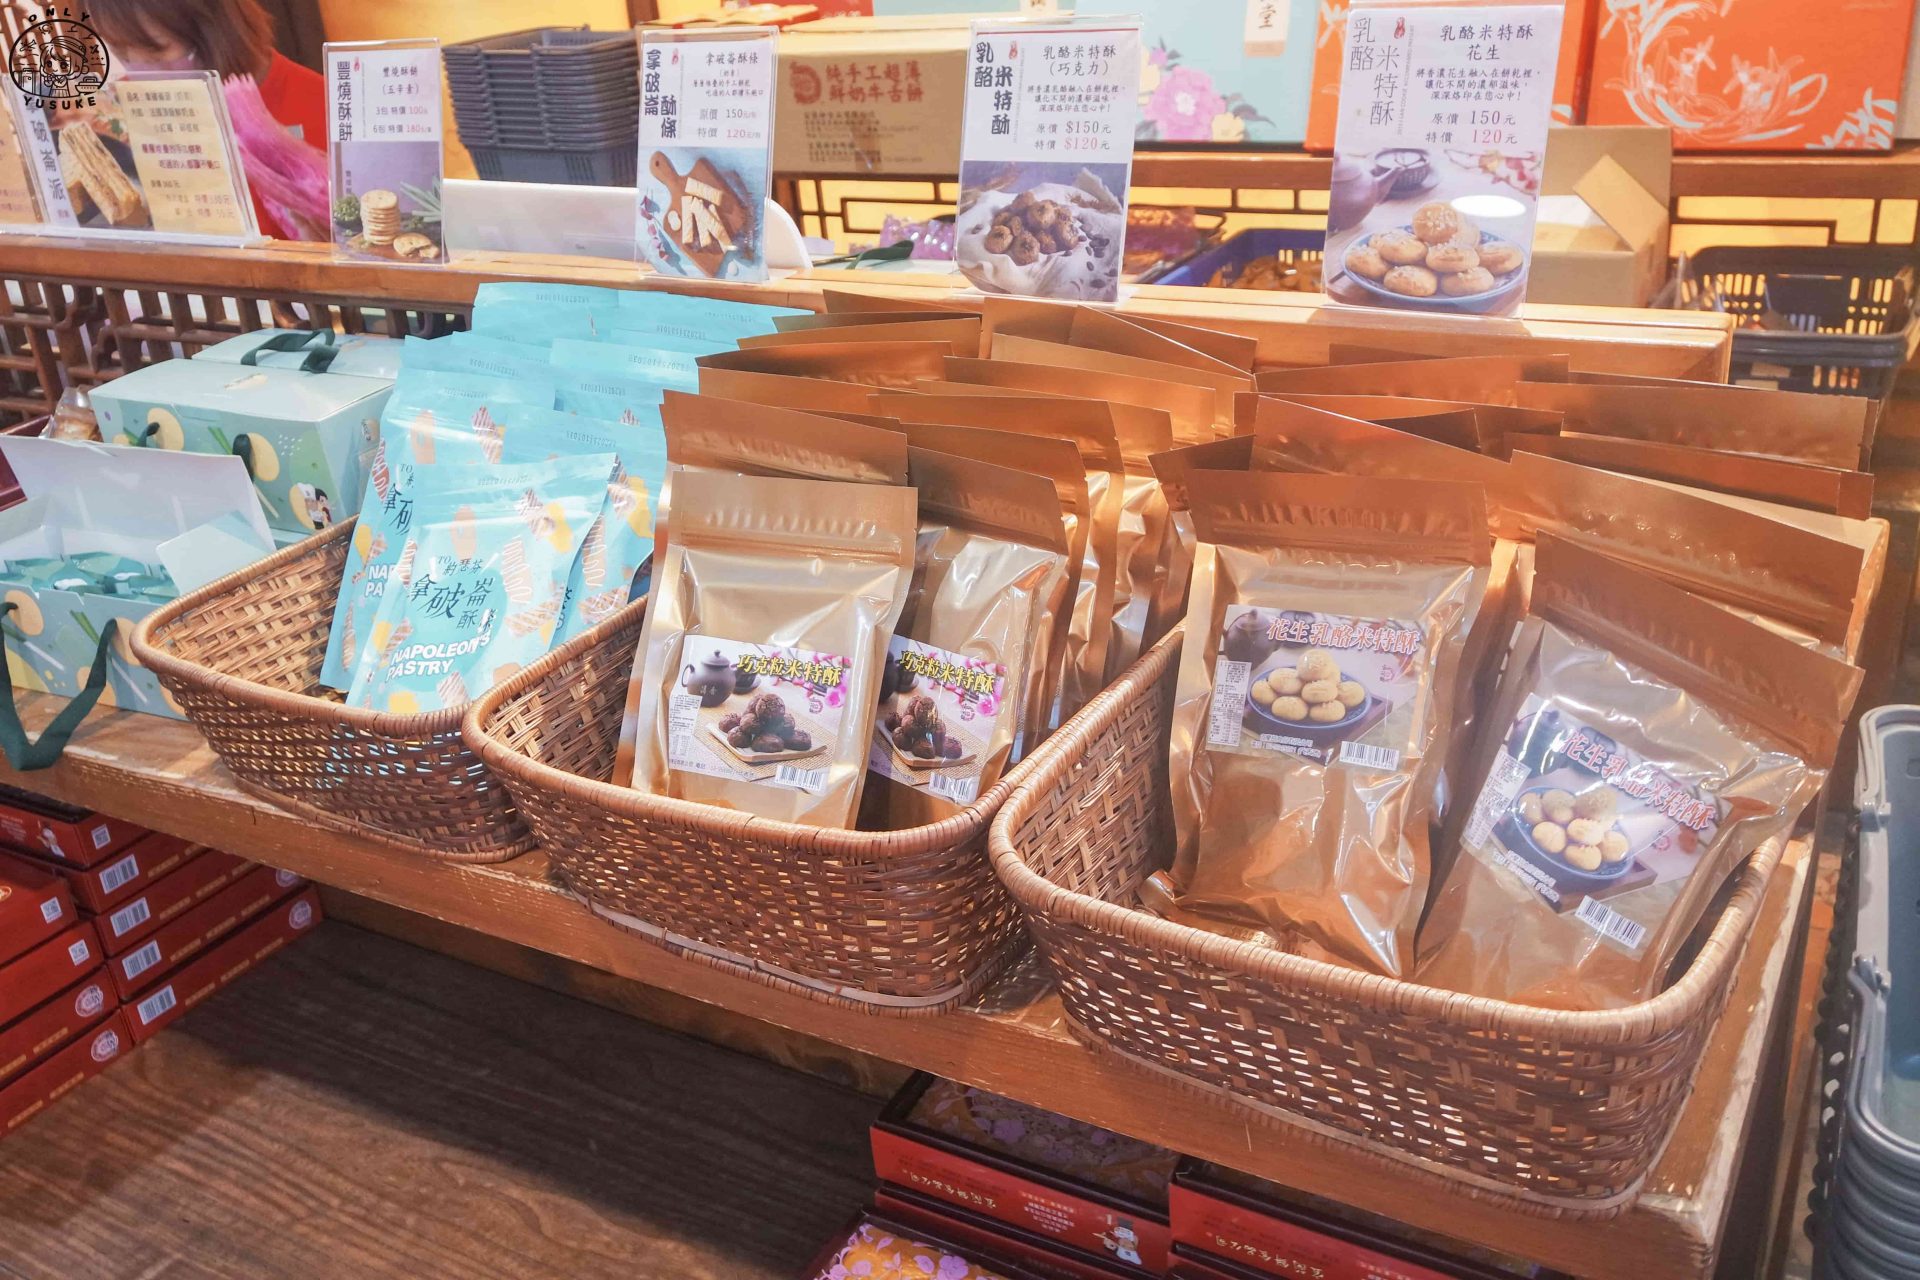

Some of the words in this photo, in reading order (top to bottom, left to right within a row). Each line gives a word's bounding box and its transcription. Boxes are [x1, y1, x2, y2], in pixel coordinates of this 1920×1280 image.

[1350, 17, 1376, 71] 乳酪
[1440, 24, 1534, 41] 乳酪米特酥
[706, 52, 758, 66] 拿破崙酥條
[974, 41, 994, 87] 乳酪
[1043, 45, 1117, 60] 乳酪米特酥
[1049, 61, 1110, 76] (巧克力)
[1467, 44, 1501, 61] 花生
[644, 49, 661, 116] 拿破崙
[1370, 45, 1400, 126] 米特酥
[337, 61, 352, 141] 豐燒酥餅
[660, 94, 677, 138] 酥條
[991, 65, 1013, 135] 米特酥
[1037, 123, 1058, 134] 原價
[1432, 113, 1459, 125] 原價
[1034, 140, 1057, 150] 特價
[1425, 131, 1452, 144] 特價
[408, 573, 494, 619] 拿破崙
[391, 632, 492, 666] NAPOLEON'S
[1267, 618, 1420, 655] 花生乳酪米特酥
[386, 659, 454, 683] PASTRY
[737, 653, 843, 687] 巧克粒米特酥
[900, 650, 996, 694] 巧克粒米特酥
